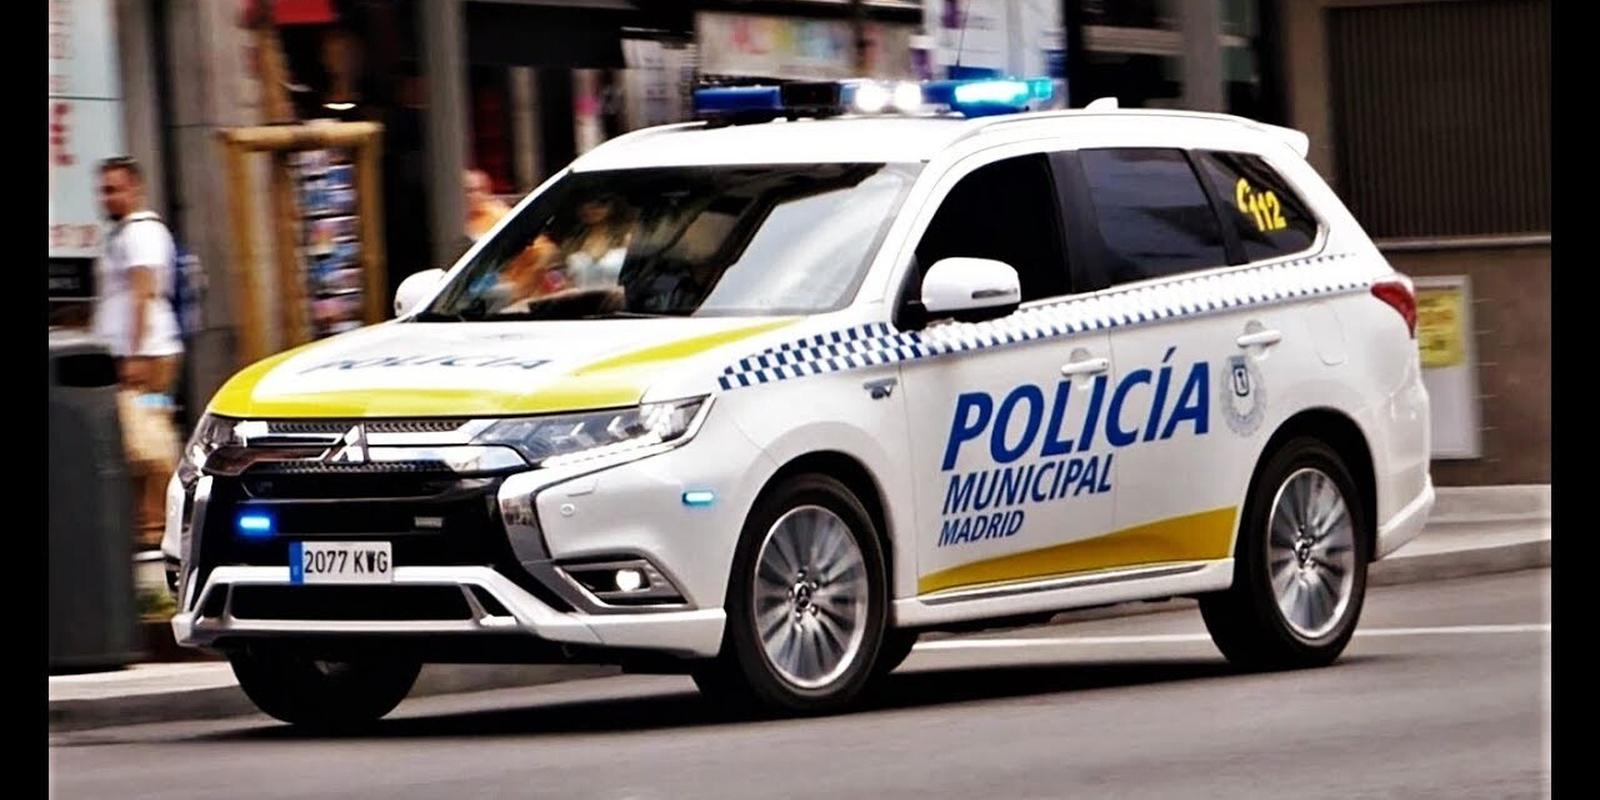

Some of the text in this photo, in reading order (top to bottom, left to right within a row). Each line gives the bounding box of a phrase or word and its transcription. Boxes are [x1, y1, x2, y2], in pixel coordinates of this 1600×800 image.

[1249, 190, 1287, 232] 112
[941, 347, 1209, 471] POLICÍA
[942, 453, 1113, 516] MUNICIPAL
[938, 510, 1024, 547] MADRID
[304, 550, 347, 574] 2077
